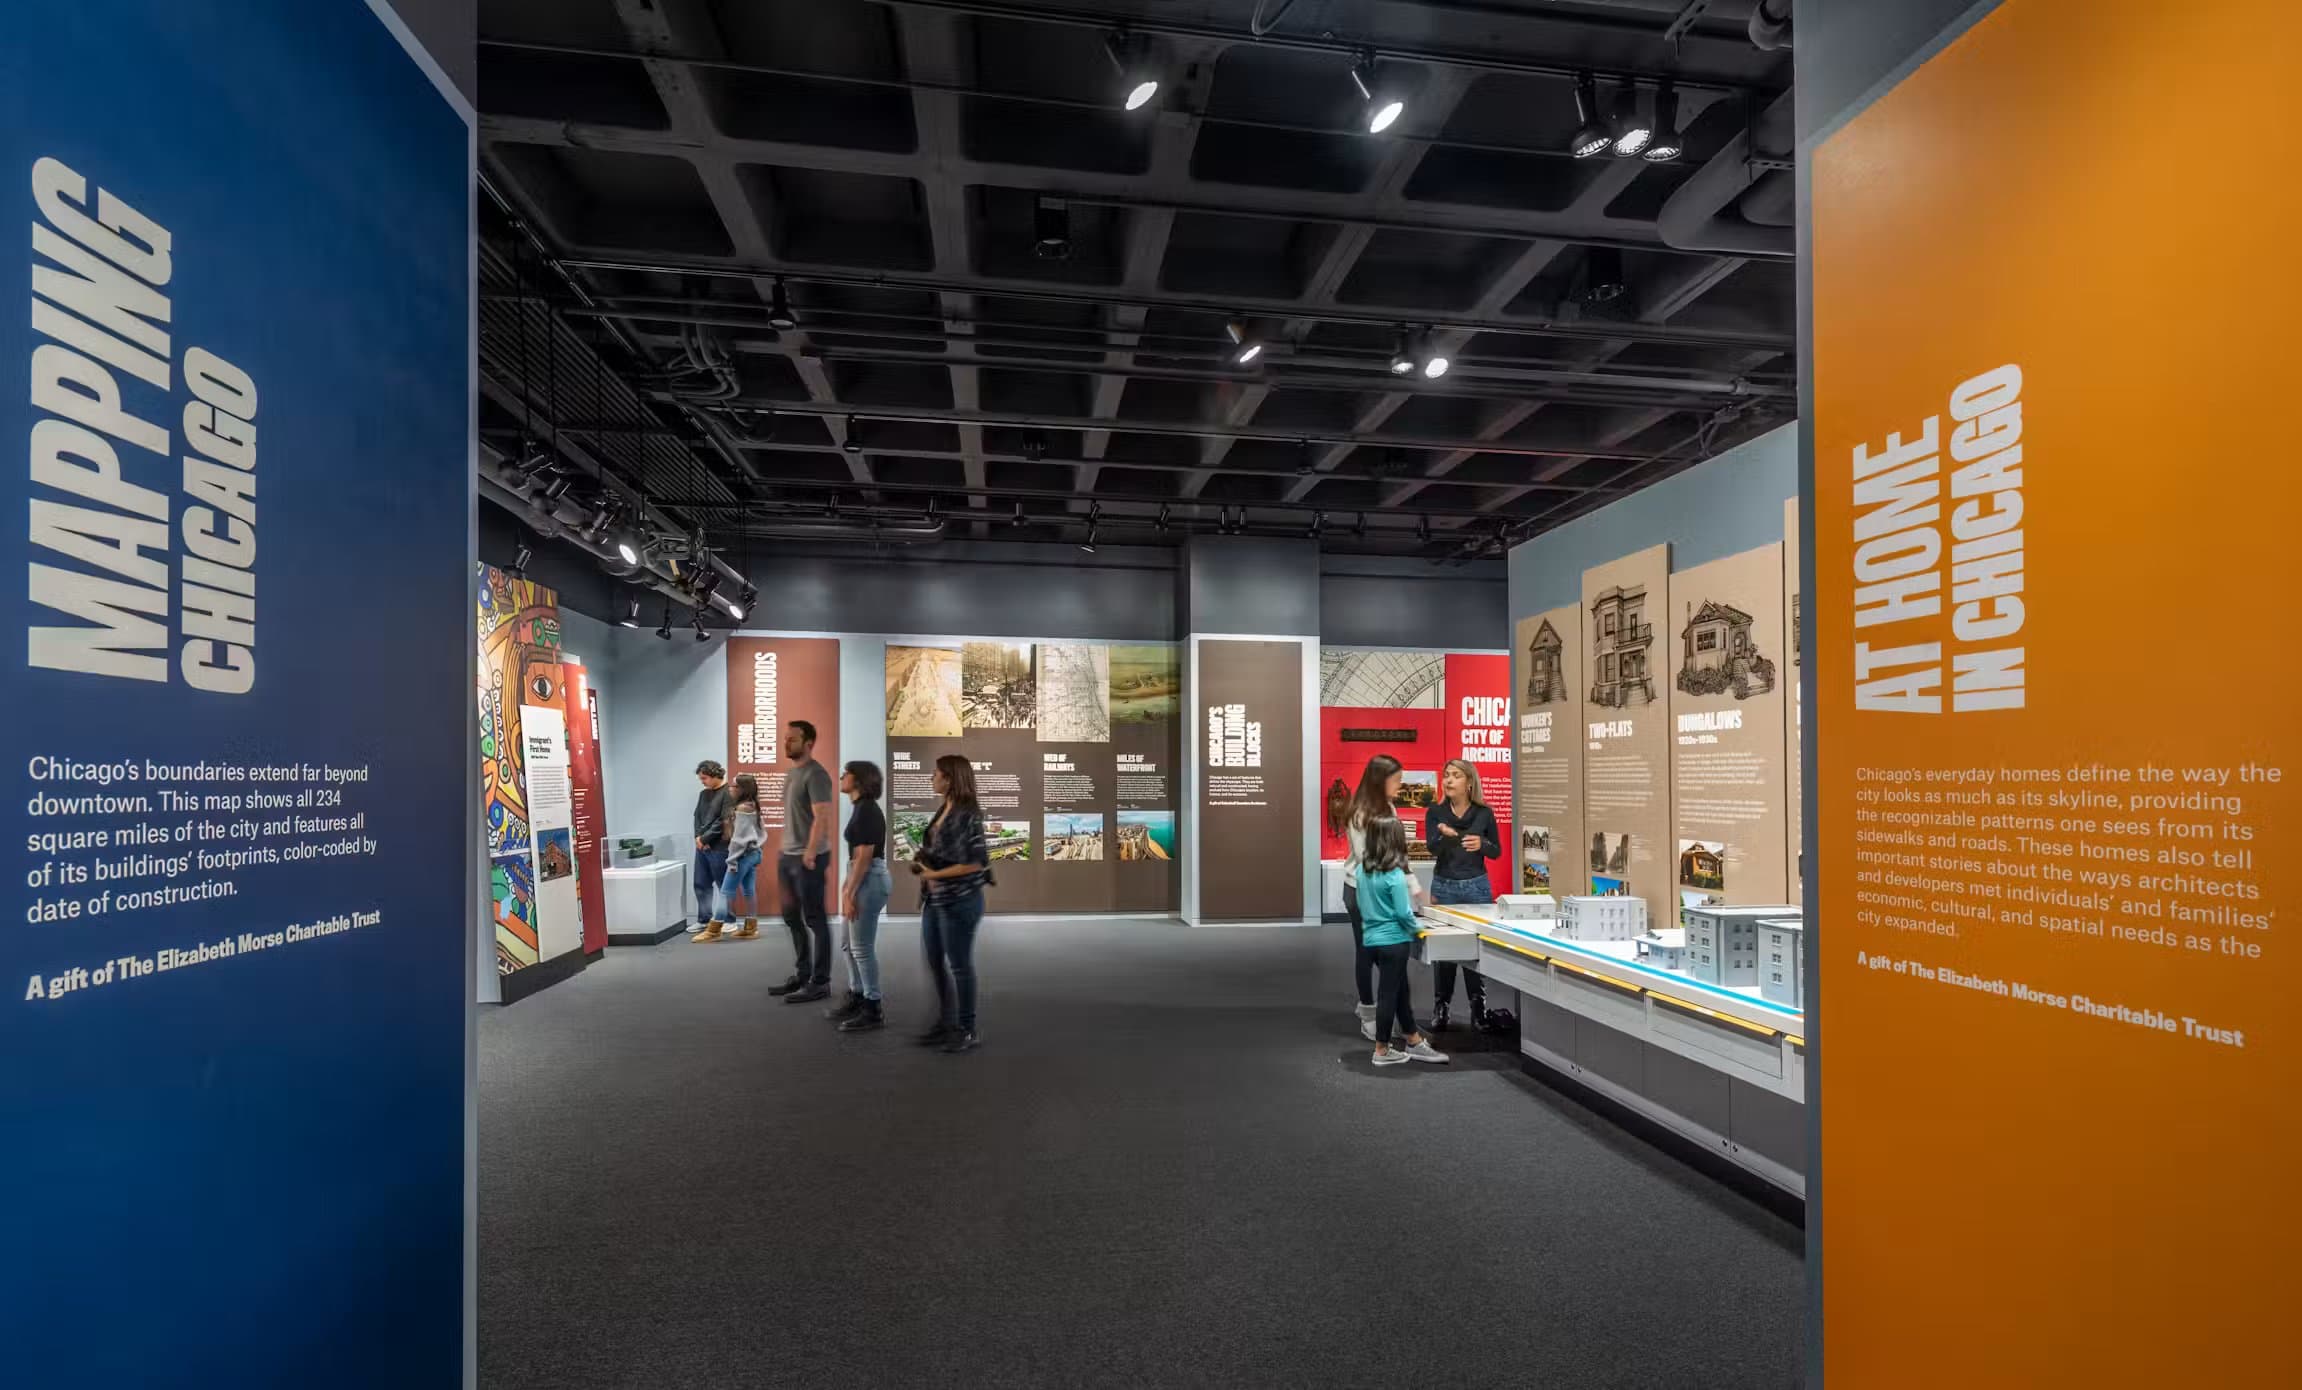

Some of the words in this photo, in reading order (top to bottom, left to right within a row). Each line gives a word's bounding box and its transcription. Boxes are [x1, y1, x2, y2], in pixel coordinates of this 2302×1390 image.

[28, 156, 172, 684] MAPPING
[181, 345, 257, 695] CHICAGO
[1852, 414, 1942, 629] HOME
[1950, 363, 2026, 642] CHICAGO
[1855, 640, 1942, 714] AT
[1952, 647, 2026, 713] IN
[754, 651, 777, 764] NEIGHBORHOODS
[1588, 719, 1633, 740] TWO-FLATS
[1677, 709, 1743, 733] BUNGALOWS
[738, 723, 754, 764] SEEING
[1208, 705, 1224, 767] CHICAGO'S
[1224, 703, 1246, 767] BUILDING
[1246, 721, 1261, 768] BLOCKS
[1461, 728, 1489, 745] CITY
[1489, 728, 1505, 745] OF
[1461, 746, 1511, 763] ARCHITE
[29, 756, 139, 785] Chicago's
[146, 759, 245, 782] boundaries
[250, 764, 298, 782] extend
[303, 765, 321, 782] far
[324, 765, 368, 785] beyond
[1117, 763, 1156, 772] WATERFRONT
[1857, 768, 1921, 783] Chicago's
[1926, 768, 1994, 784] everyday
[2000, 766, 2061, 782] homes
[2067, 765, 2131, 782] define
[2139, 764, 2173, 782] the
[2182, 767, 2230, 786] way
[2239, 762, 2281, 782] the
[28, 793, 153, 816] downtown.
[159, 791, 199, 812] This
[204, 794, 241, 814] map
[245, 791, 294, 809] shows
[297, 791, 312, 807] all
[316, 790, 341, 806] 234
[1857, 788, 1879, 805] city
[1884, 788, 1920, 802] looks
[1925, 792, 1941, 803] as
[1946, 789, 1992, 804] much
[1997, 793, 2015, 805] as
[2021, 790, 2043, 806] its
[2048, 791, 2122, 810] skyline,
[2131, 793, 2241, 815] providing
[1857, 808, 1877, 822] the
[1881, 810, 1976, 829] recognizable
[1981, 813, 2054, 833] patterns
[2060, 818, 2096, 833] one
[2103, 819, 2150, 835] sees
[2158, 818, 2213, 838] from
[2223, 821, 2253, 840] its
[28, 828, 108, 855] square
[115, 823, 169, 845] miles
[175, 821, 194, 841] of
[198, 820, 226, 840] the
[230, 819, 259, 840] city
[263, 817, 290, 836] and
[294, 814, 347, 833] features
[350, 813, 364, 829] all
[1857, 829, 1923, 846] sidewalks
[1928, 833, 1956, 849] and
[1962, 835, 2011, 852] roads.
[2017, 836, 2073, 857] These
[2080, 841, 2149, 862] homes
[2157, 847, 2205, 866] also
[2213, 849, 2251, 869] tell
[28, 864, 52, 888] of
[60, 862, 87, 884] its
[96, 852, 192, 880] buildings'
[197, 847, 280, 871] footprints,
[284, 839, 360, 860] color-coded
[363, 837, 377, 855] by
[1857, 849, 1925, 869] important
[1930, 855, 1982, 873] stories
[1987, 859, 2036, 879] about
[2043, 863, 2072, 881] the
[2080, 869, 2131, 889] ways
[2138, 874, 2259, 899] architects
[28, 896, 80, 923] date
[88, 892, 109, 915] of
[116, 880, 238, 911] construction.
[1857, 869, 1881, 883] and
[1885, 871, 1963, 895] developers
[1969, 880, 2001, 897] met
[2007, 885, 2114, 911] individuals'
[2121, 897, 2160, 917] and
[2169, 901, 2274, 929] families'
[1857, 908, 1880, 926] city
[1885, 913, 1959, 937] expanded.
[1857, 890, 1927, 911] economic,
[1931, 897, 1995, 922] cultural,
[2000, 908, 2033, 925] and
[2039, 914, 2103, 936] spatial
[2111, 923, 2177, 947] needs
[2185, 935, 2211, 952] as
[2220, 935, 2261, 958] the
[26, 975, 44, 1000] A
[49, 967, 88, 999] gift
[93, 962, 114, 986] of
[117, 955, 153, 980] The
[157, 939, 235, 972] Elizabeth
[238, 931, 283, 953] Morse
[286, 913, 350, 942] Charitable
[352, 910, 380, 928] Trust
[1858, 952, 1866, 965] A
[1870, 955, 1891, 972] gift
[1894, 959, 1907, 973] of
[1910, 962, 1935, 980] The
[1938, 968, 2008, 995] Elizabeth
[2012, 982, 2066, 1008] Morse
[2072, 995, 2176, 1032] Charitable
[2182, 1017, 2243, 1047] Trust
